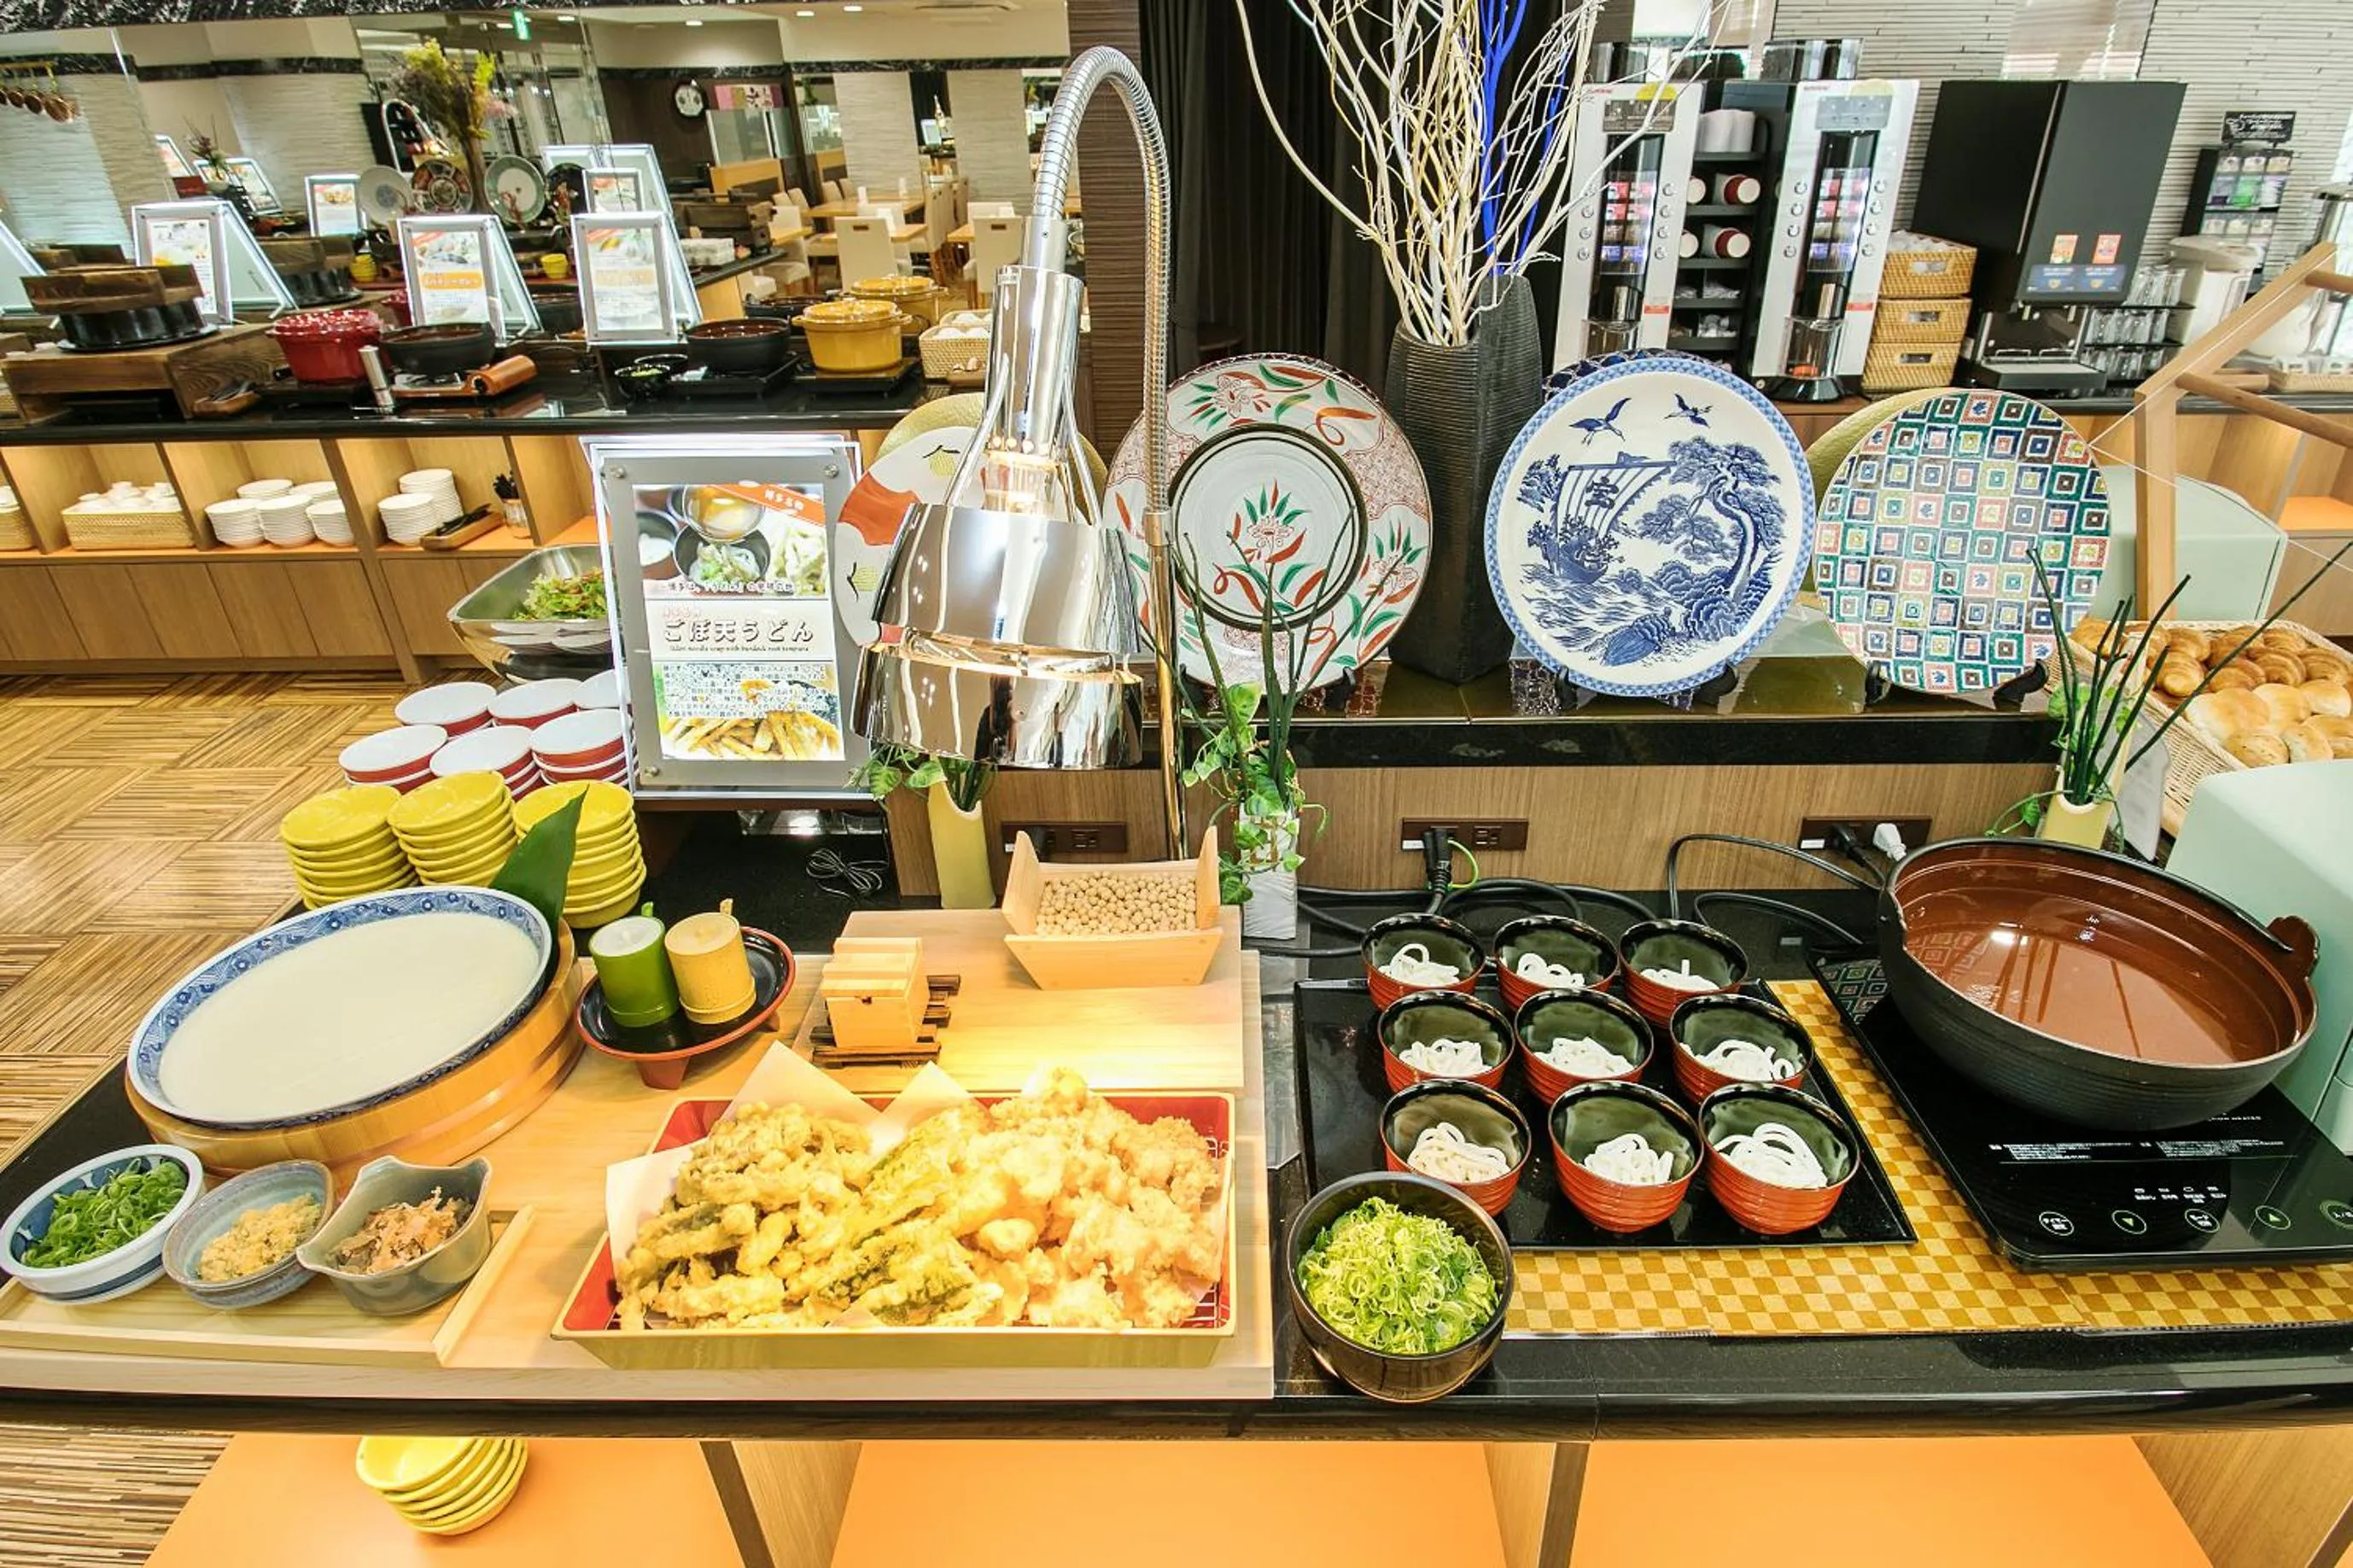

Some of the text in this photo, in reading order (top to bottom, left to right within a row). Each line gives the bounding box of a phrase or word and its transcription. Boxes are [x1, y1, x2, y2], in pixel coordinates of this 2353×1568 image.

[664, 618, 814, 642] ごぼ天うどん
